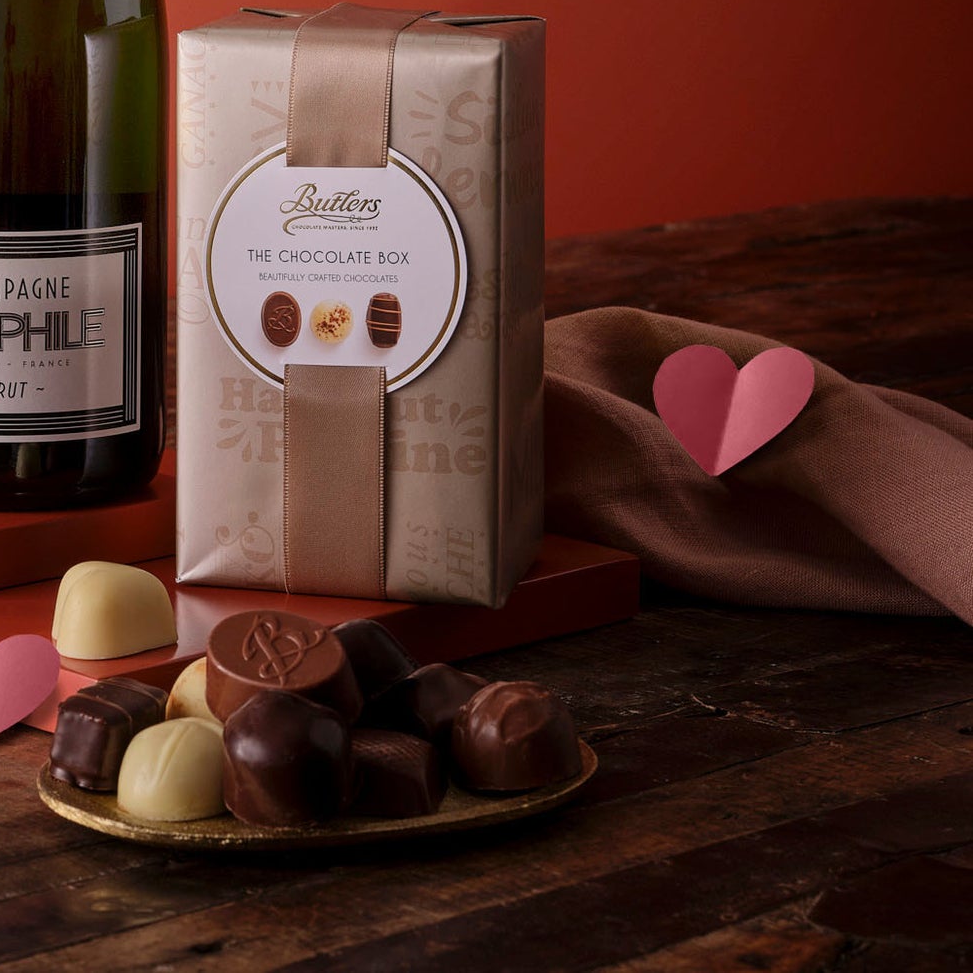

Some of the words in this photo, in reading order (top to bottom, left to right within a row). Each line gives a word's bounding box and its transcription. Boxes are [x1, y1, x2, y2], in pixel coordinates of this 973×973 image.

[279, 182, 382, 219] Butlers
[247, 249, 272, 263] THE
[278, 249, 372, 265] CHOCOLATE
[378, 251, 410, 265] BOX
[258, 272, 306, 282] BEAUTIFULLY
[308, 273, 341, 283] CRAFTED
[343, 274, 399, 284] CHOCOLATES
[22, 359, 71, 368] FRANCE
